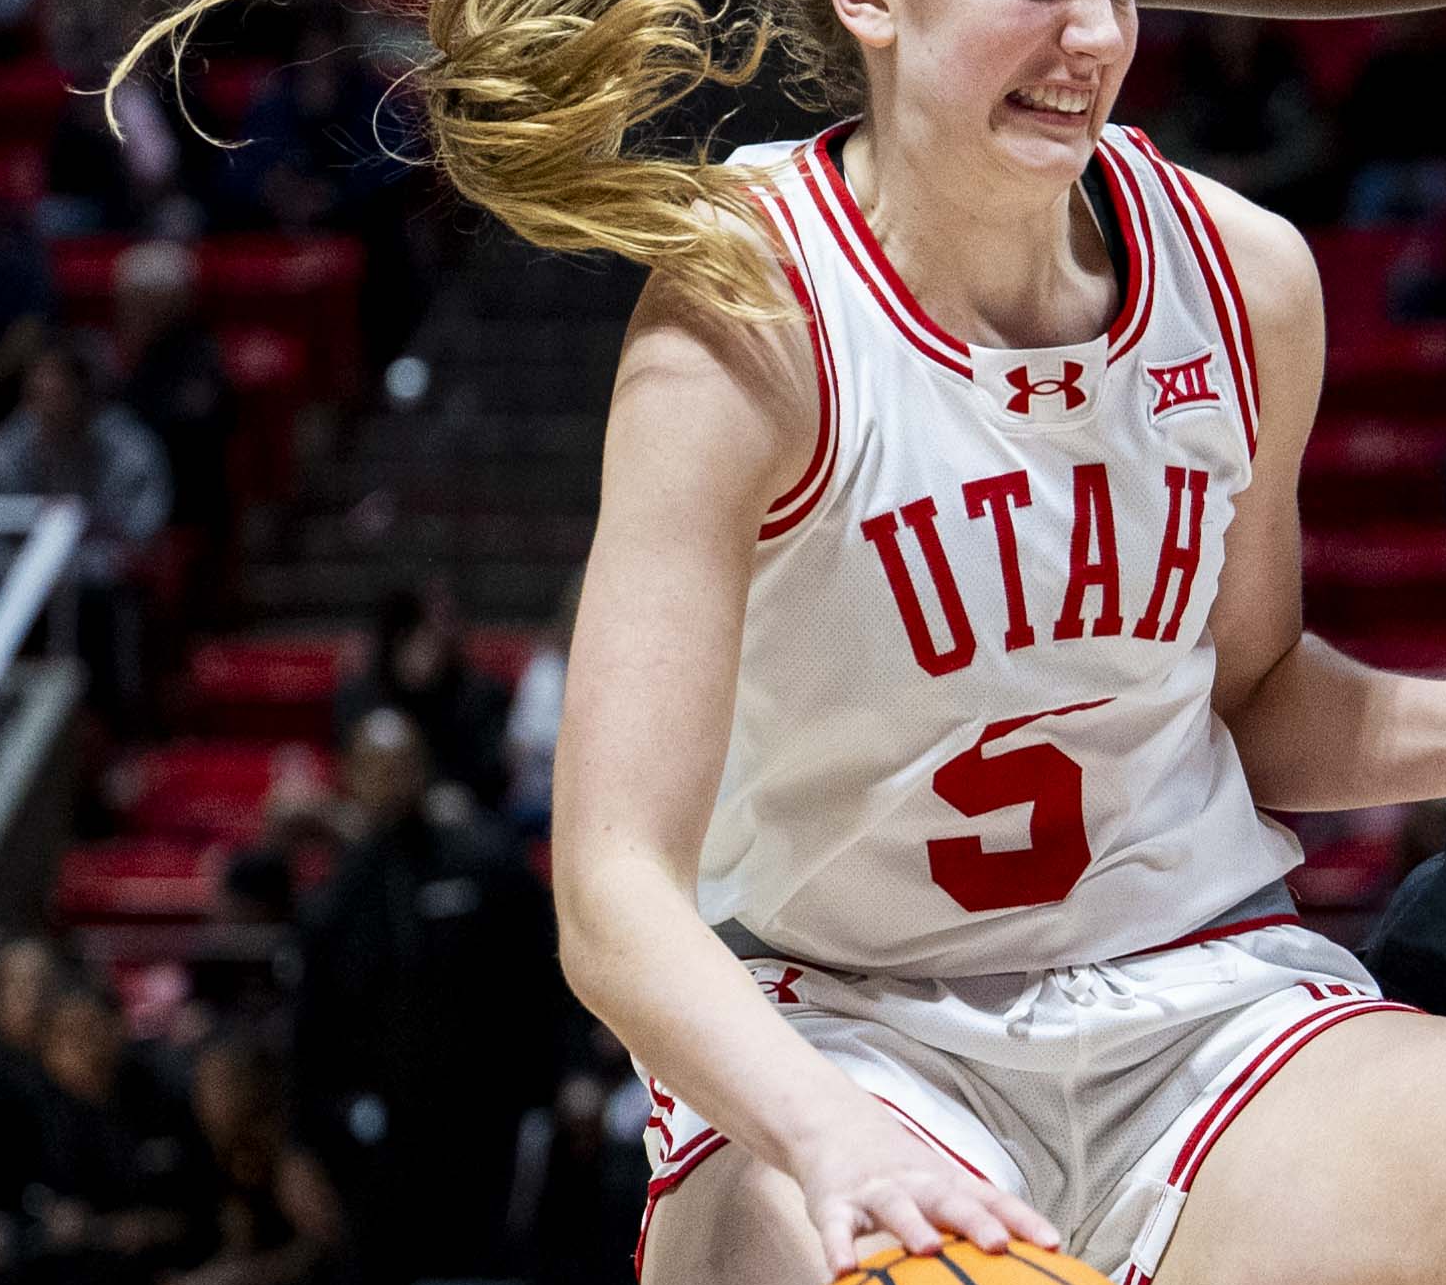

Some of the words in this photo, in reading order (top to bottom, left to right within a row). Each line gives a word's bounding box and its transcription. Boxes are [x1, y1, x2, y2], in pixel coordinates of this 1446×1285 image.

[1146, 351, 1221, 417] XII
[860, 462, 1208, 678] UTAH
[925, 697, 1116, 914] 5
